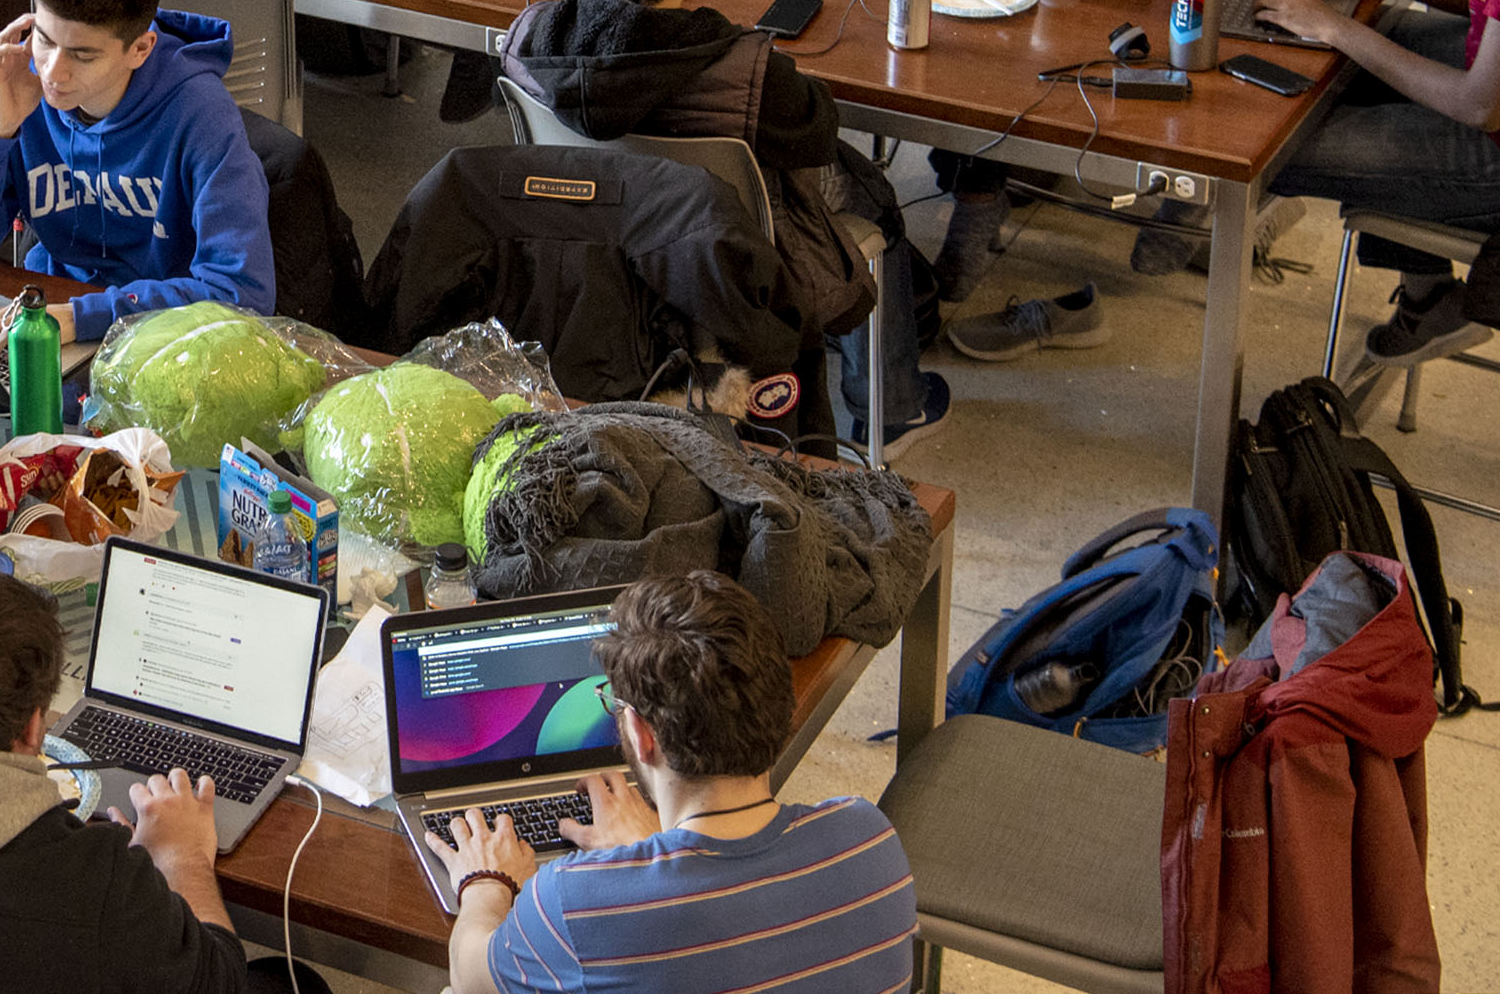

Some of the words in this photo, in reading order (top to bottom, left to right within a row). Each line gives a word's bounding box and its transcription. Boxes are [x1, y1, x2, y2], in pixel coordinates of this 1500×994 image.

[231, 488, 267, 521] NUTR
[231, 507, 258, 534] GRA
[1225, 827, 1265, 839] Columbia
